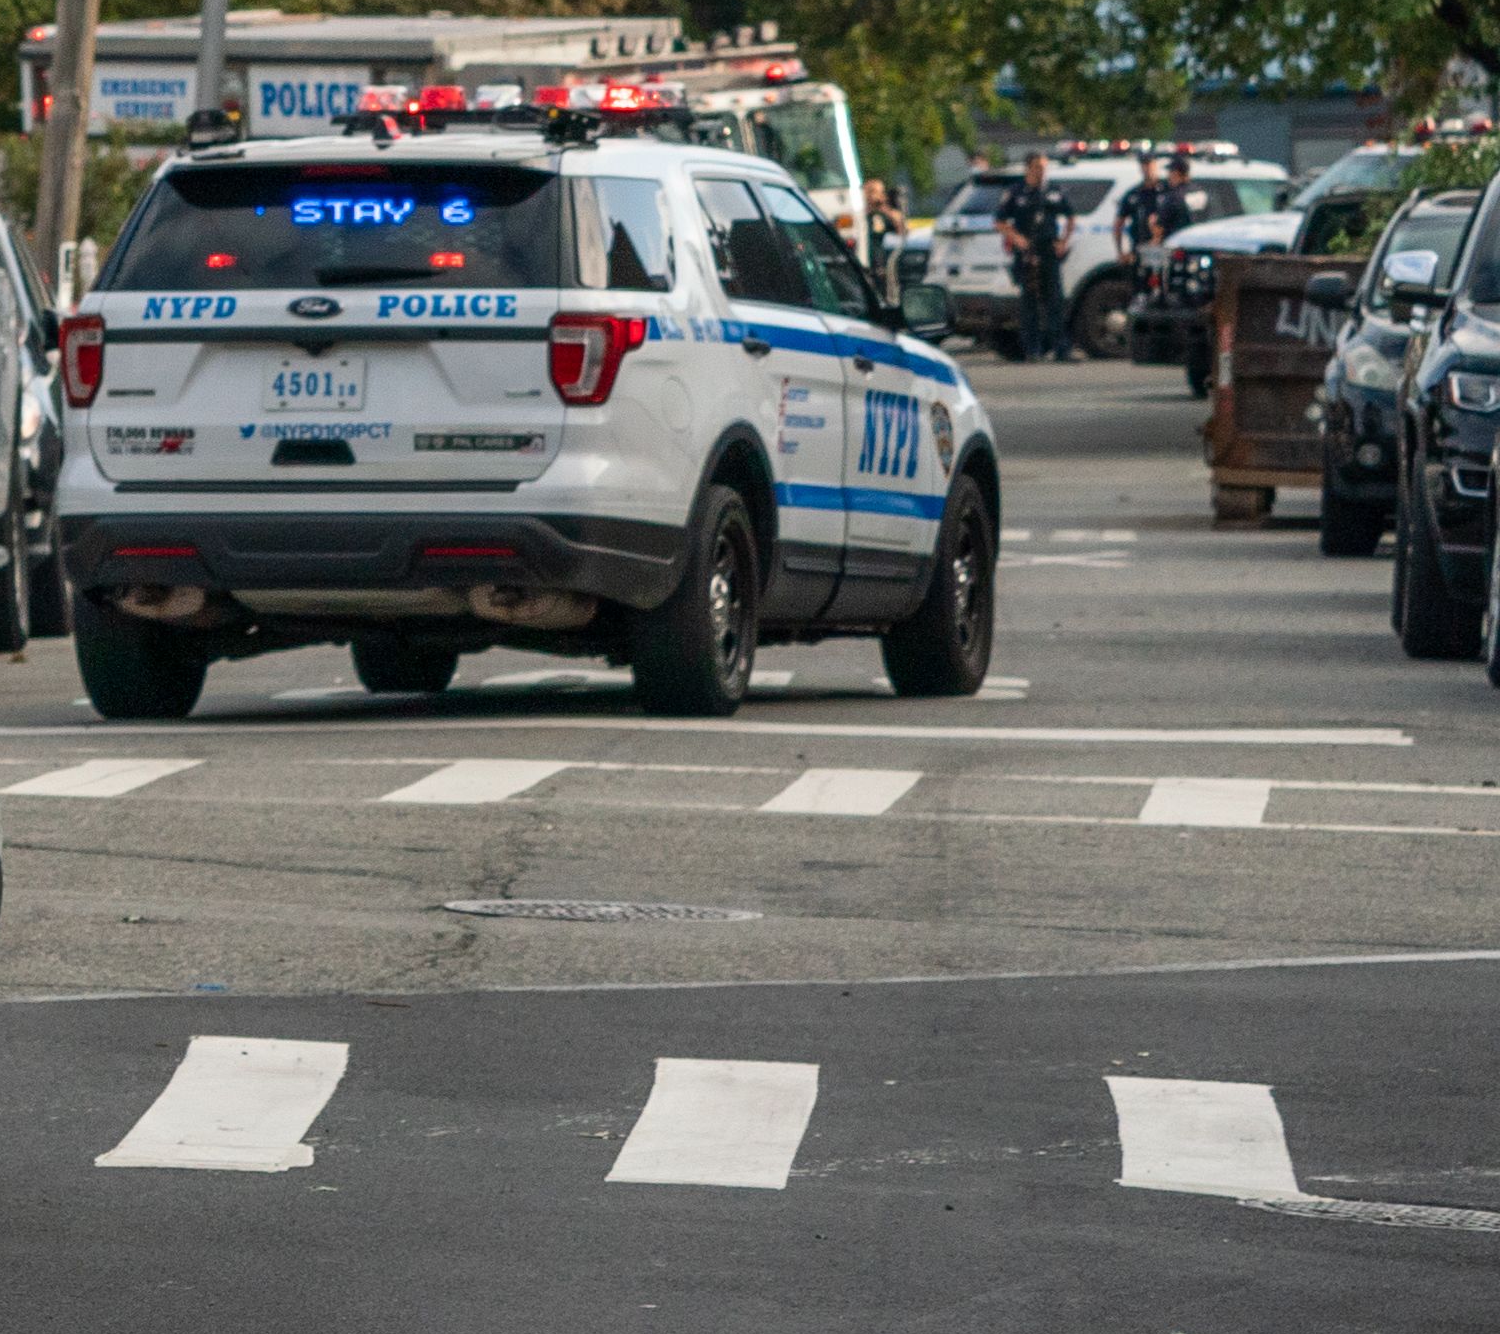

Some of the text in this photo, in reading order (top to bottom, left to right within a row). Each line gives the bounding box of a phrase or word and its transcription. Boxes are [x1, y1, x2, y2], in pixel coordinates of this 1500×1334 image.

[260, 81, 361, 117] POLICE
[293, 198, 474, 224] STAY 6
[143, 296, 238, 320] NYPD
[377, 294, 517, 318] POLICE
[272, 371, 332, 397] 4501
[858, 388, 920, 479] NYPD
